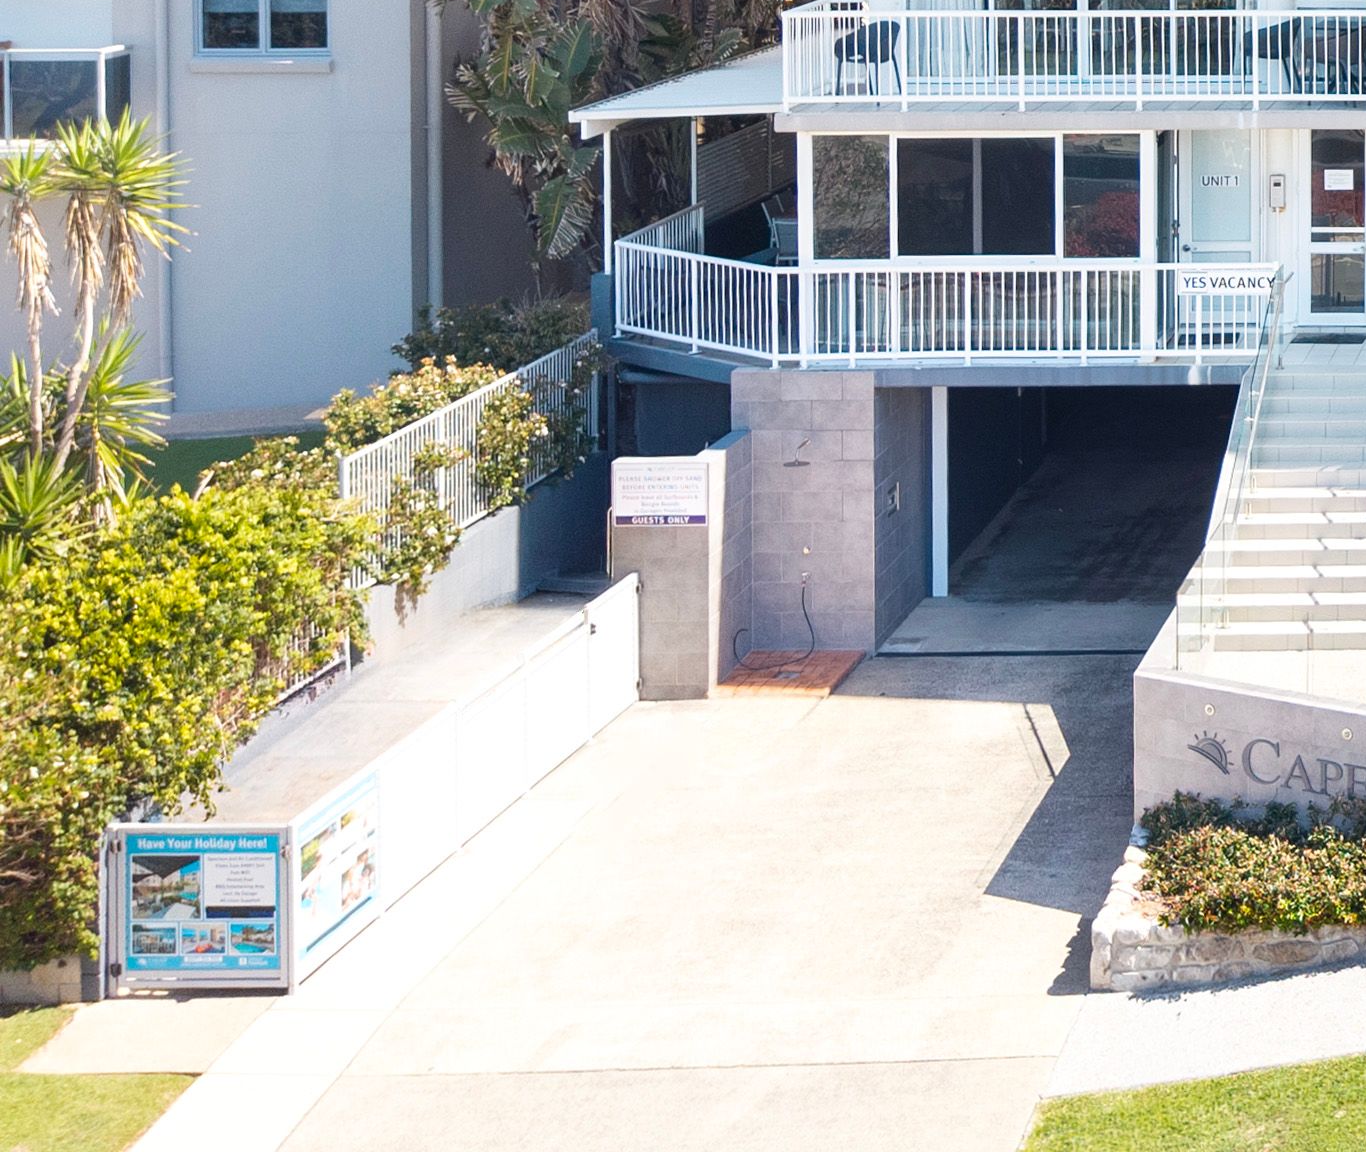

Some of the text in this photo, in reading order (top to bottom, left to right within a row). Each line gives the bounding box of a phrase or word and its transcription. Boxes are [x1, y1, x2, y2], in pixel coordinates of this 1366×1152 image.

[1202, 175, 1239, 186] UNIT 1
[1183, 276, 1276, 289] YES VACANCY
[632, 516, 690, 524] GUESTS ONLY
[137, 837, 268, 851] Have Your Holiday Here!
